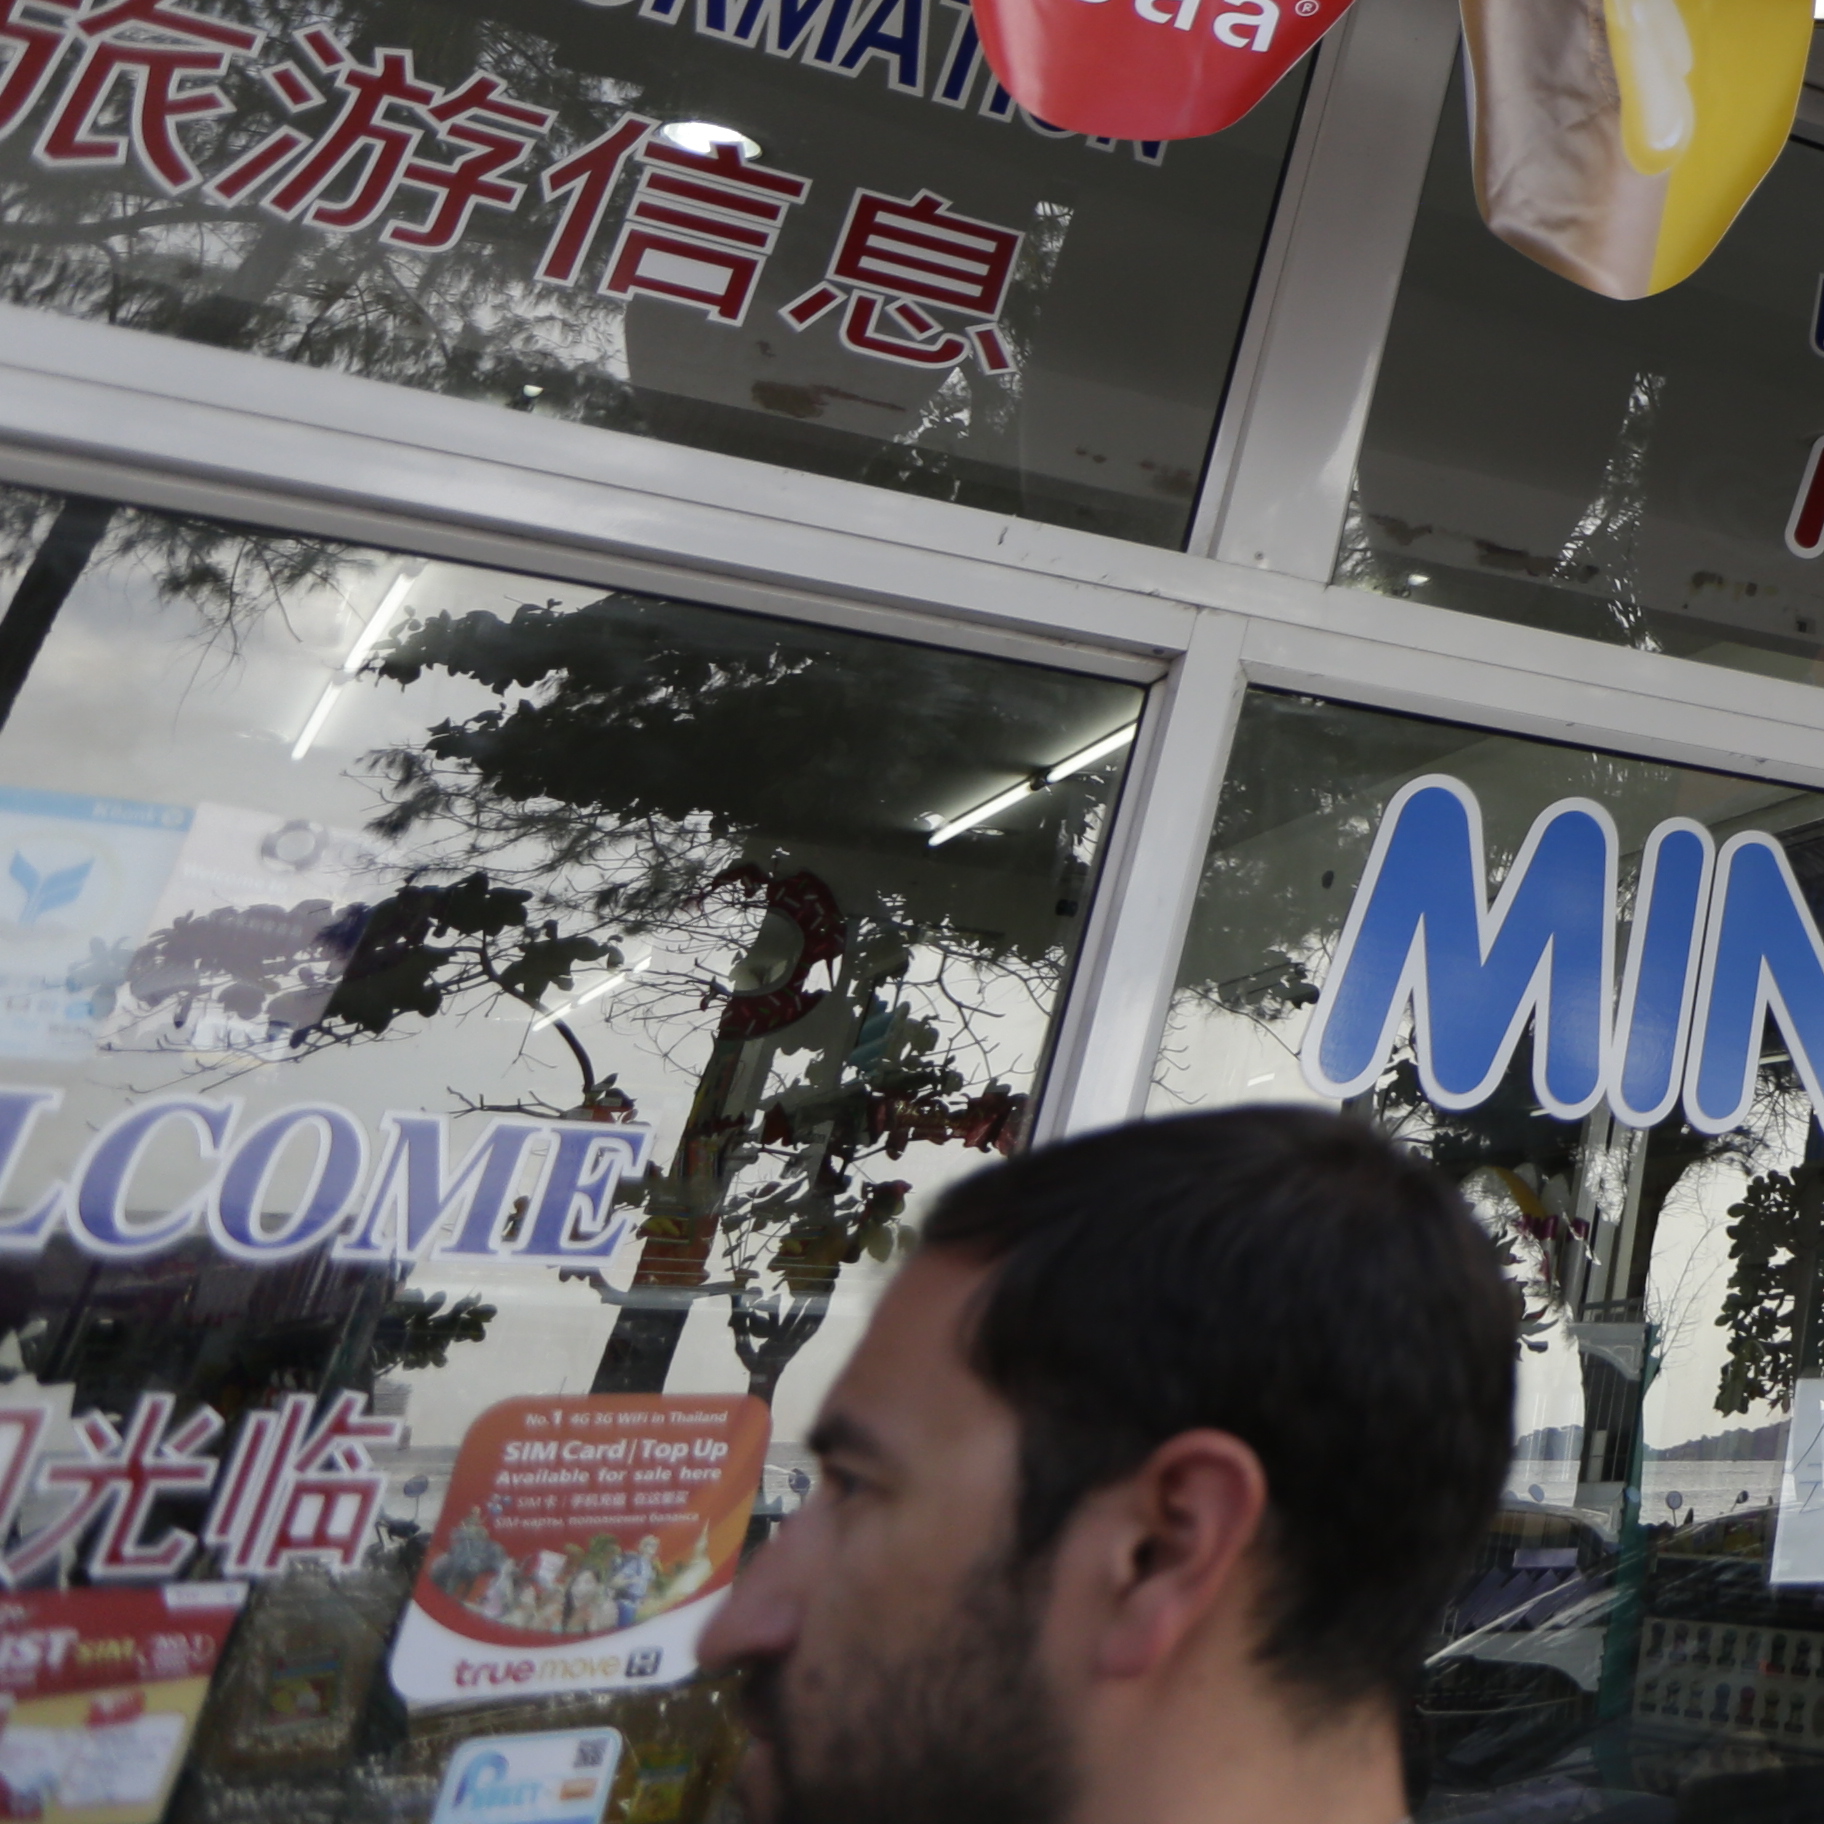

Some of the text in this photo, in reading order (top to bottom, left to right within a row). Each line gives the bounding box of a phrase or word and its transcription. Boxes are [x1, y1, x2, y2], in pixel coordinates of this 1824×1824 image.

[503, 1437, 729, 1463] SIM Card Top Up
[496, 1465, 722, 1487] Available for sale here
